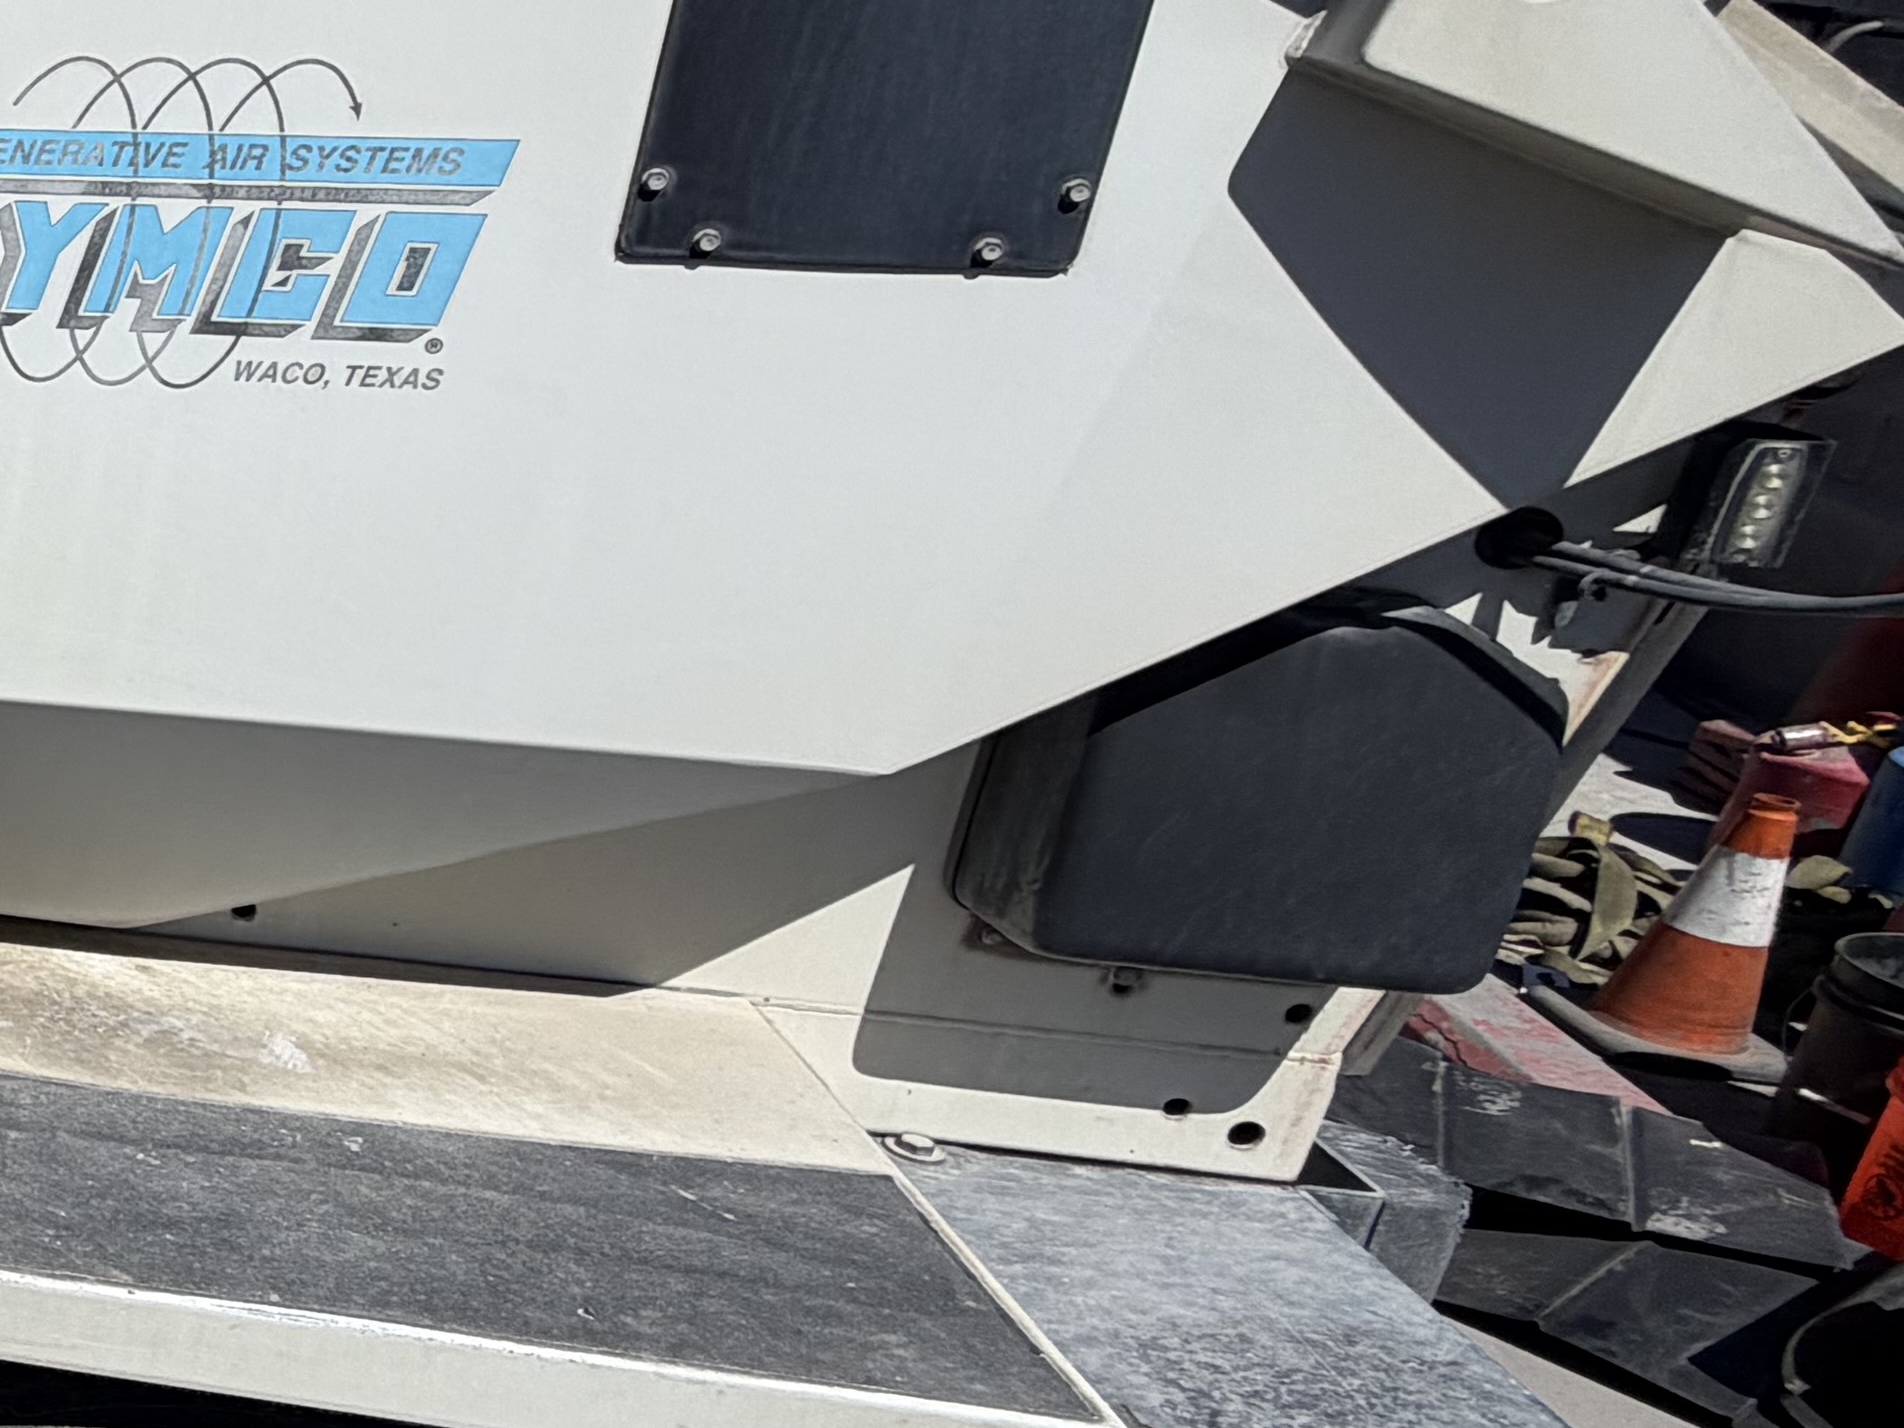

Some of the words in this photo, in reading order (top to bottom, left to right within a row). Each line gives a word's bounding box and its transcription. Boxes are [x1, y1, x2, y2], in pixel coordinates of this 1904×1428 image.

[208, 143, 265, 172] AIR
[286, 145, 465, 178] SYSTEMS
[233, 357, 331, 392] WACO,
[342, 362, 445, 392] TEXAS
